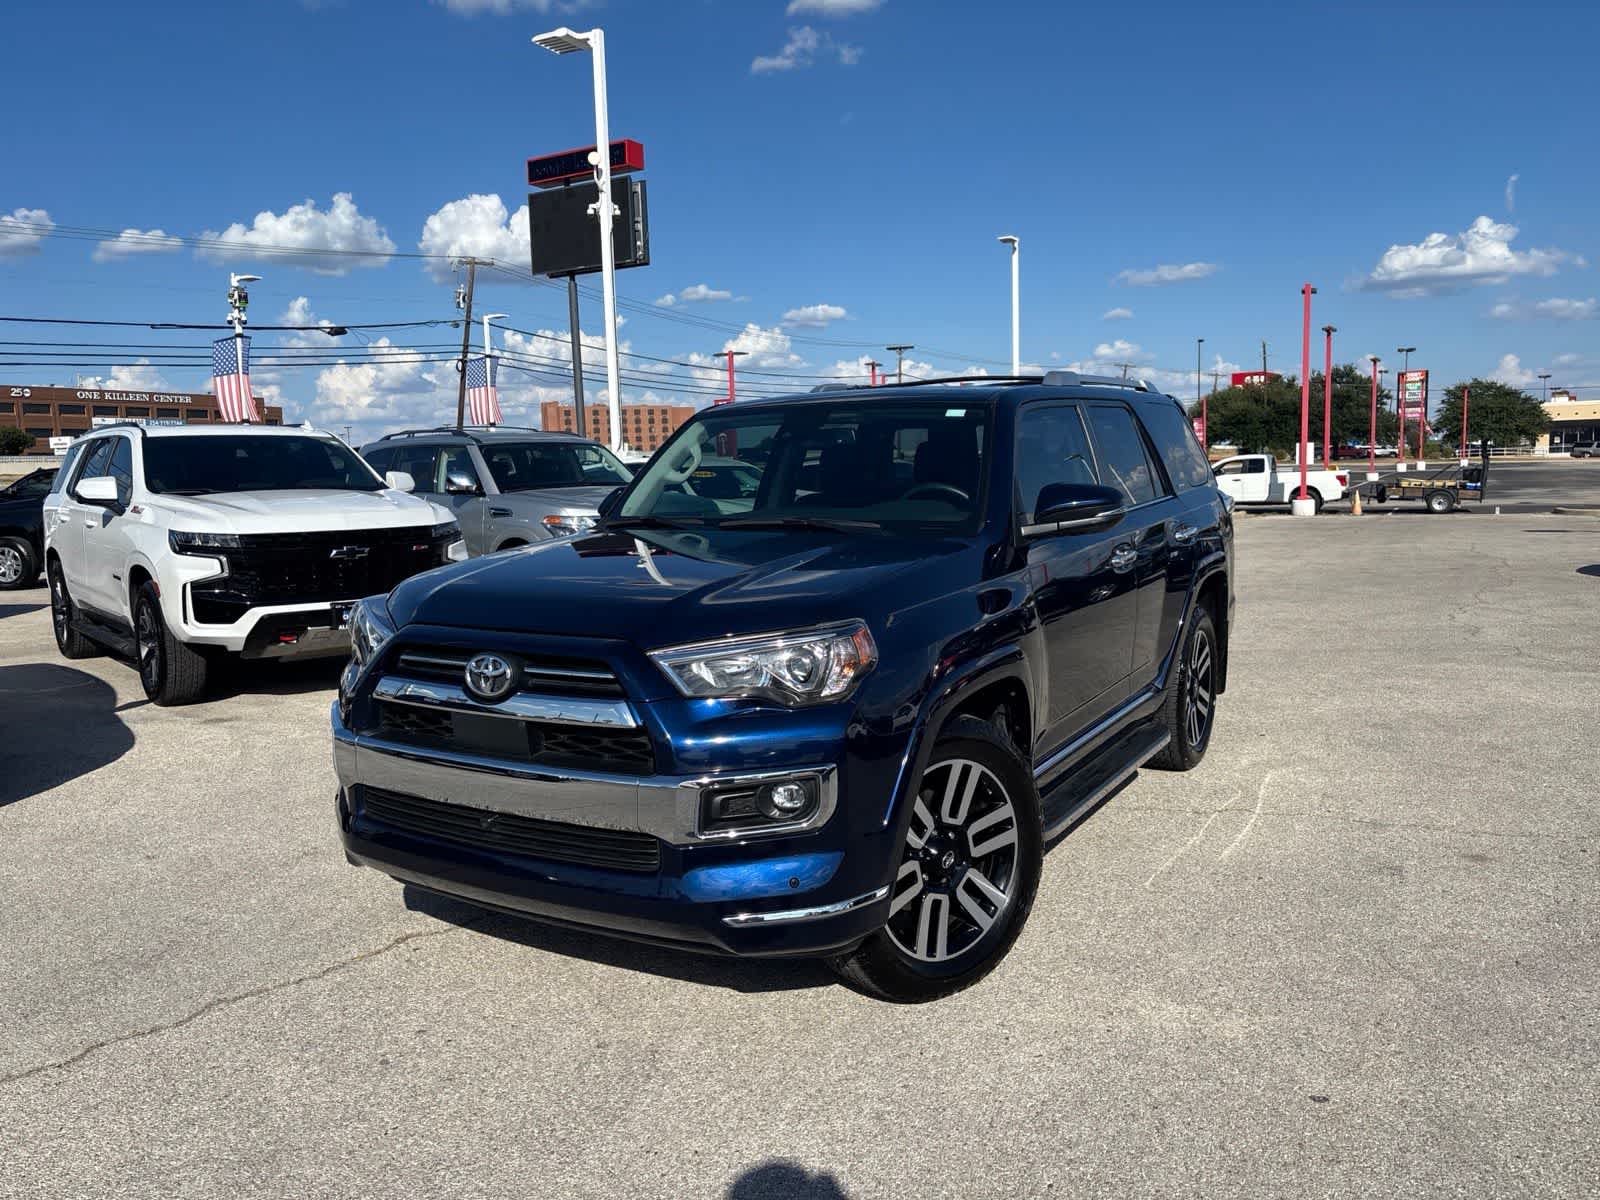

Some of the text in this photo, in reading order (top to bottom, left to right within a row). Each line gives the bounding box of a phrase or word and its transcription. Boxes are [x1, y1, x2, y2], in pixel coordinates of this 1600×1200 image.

[76, 391, 192, 405] ONE KILLEEN CENTER
